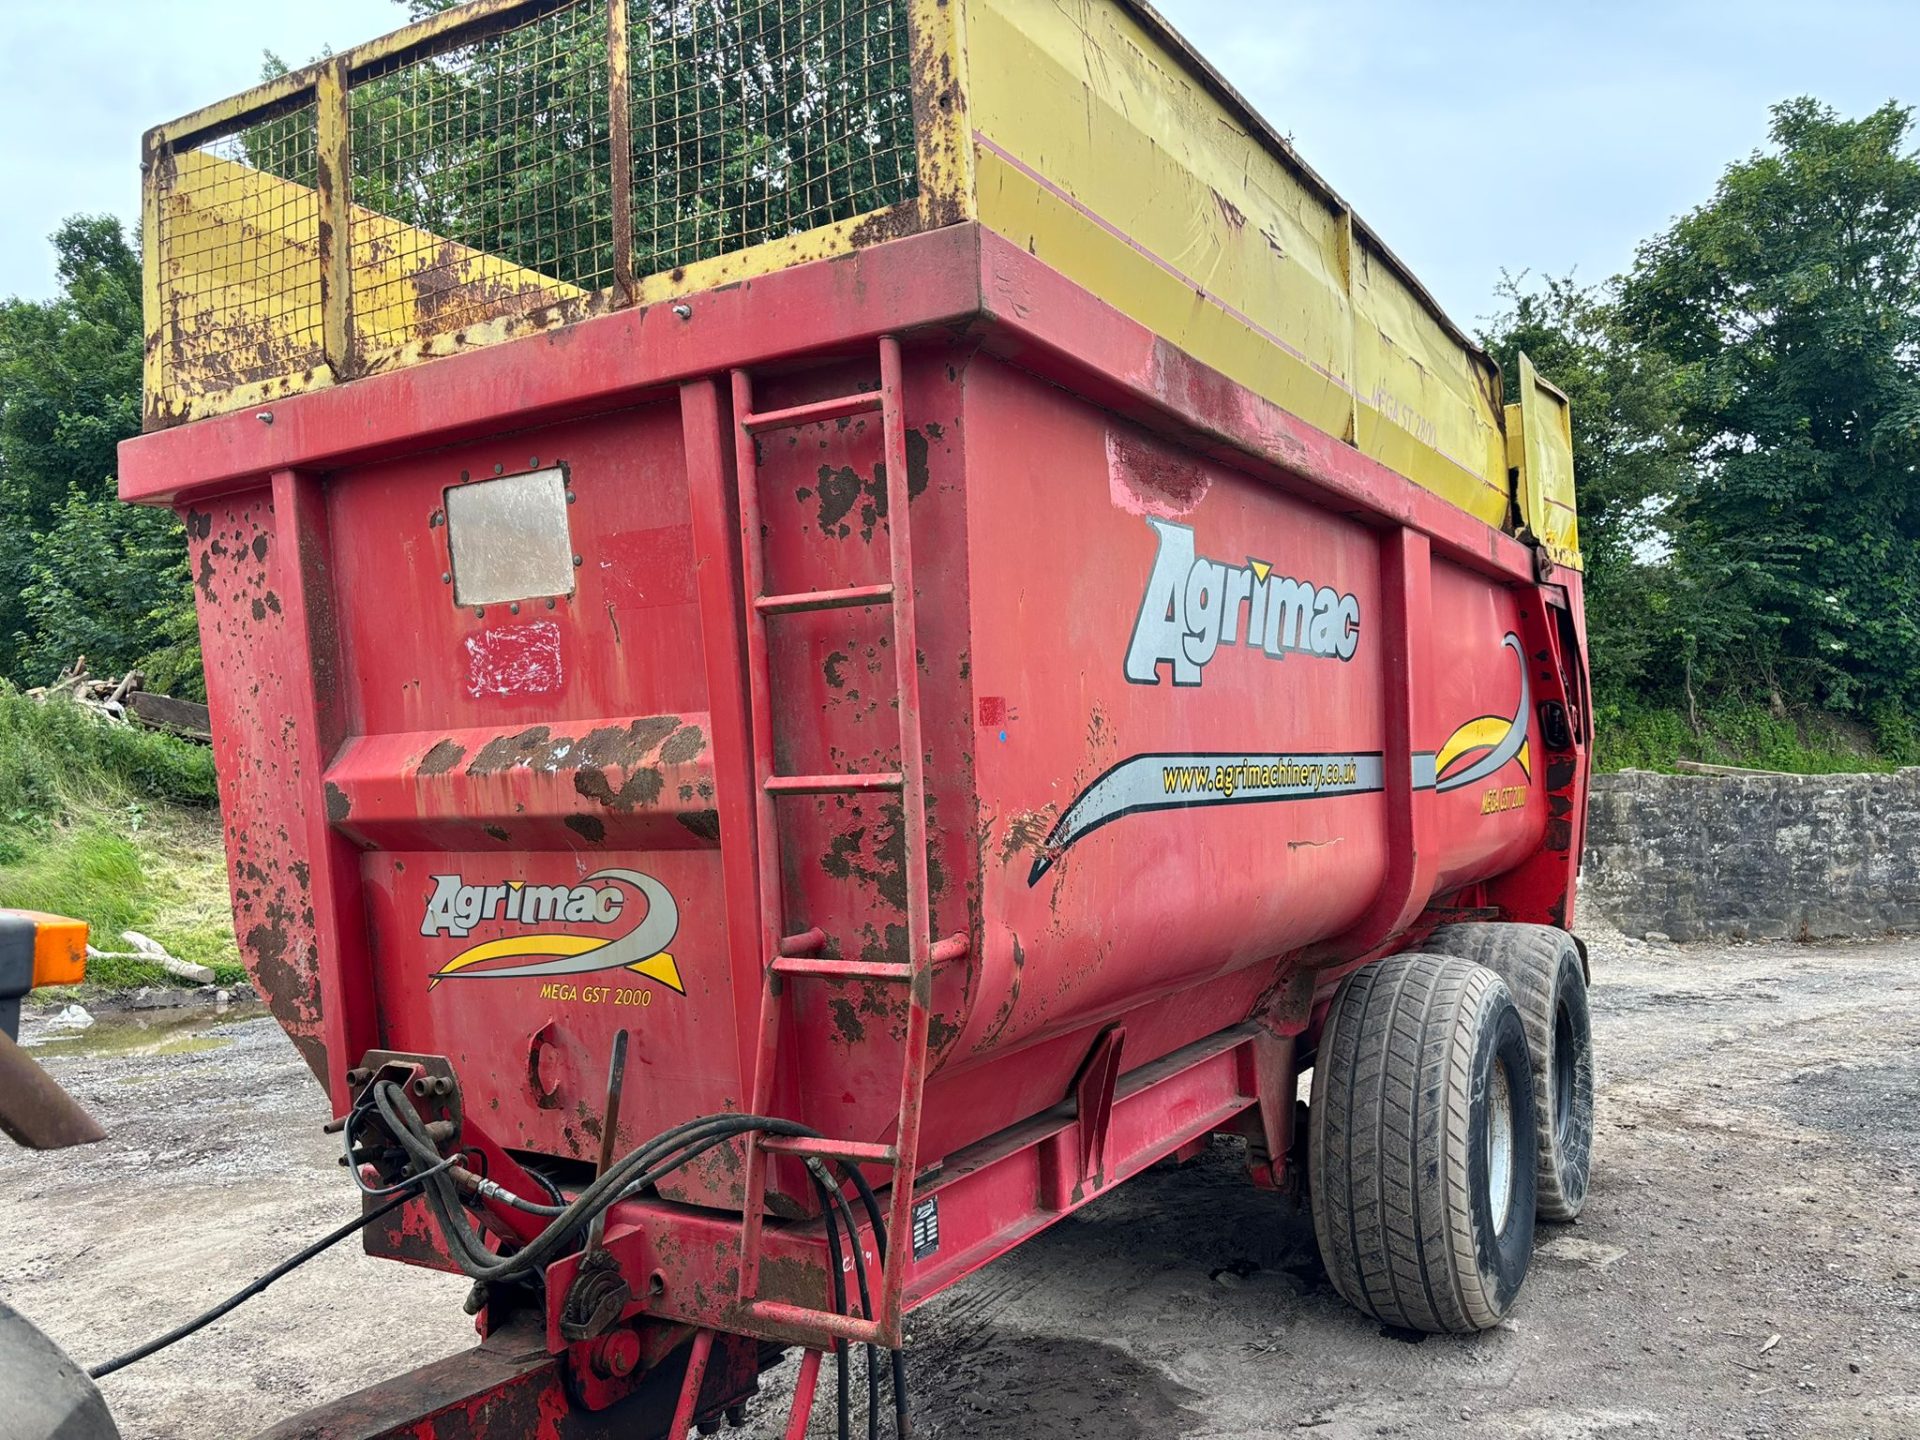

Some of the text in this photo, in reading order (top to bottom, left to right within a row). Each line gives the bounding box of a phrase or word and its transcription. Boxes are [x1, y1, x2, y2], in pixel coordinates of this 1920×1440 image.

[1124, 516, 1360, 687] Agrimac
[1163, 758, 1356, 797] www.agrimachinery.co.uk
[420, 874, 624, 937] Agrimac
[539, 983, 651, 1007] MEGA GST 2000
